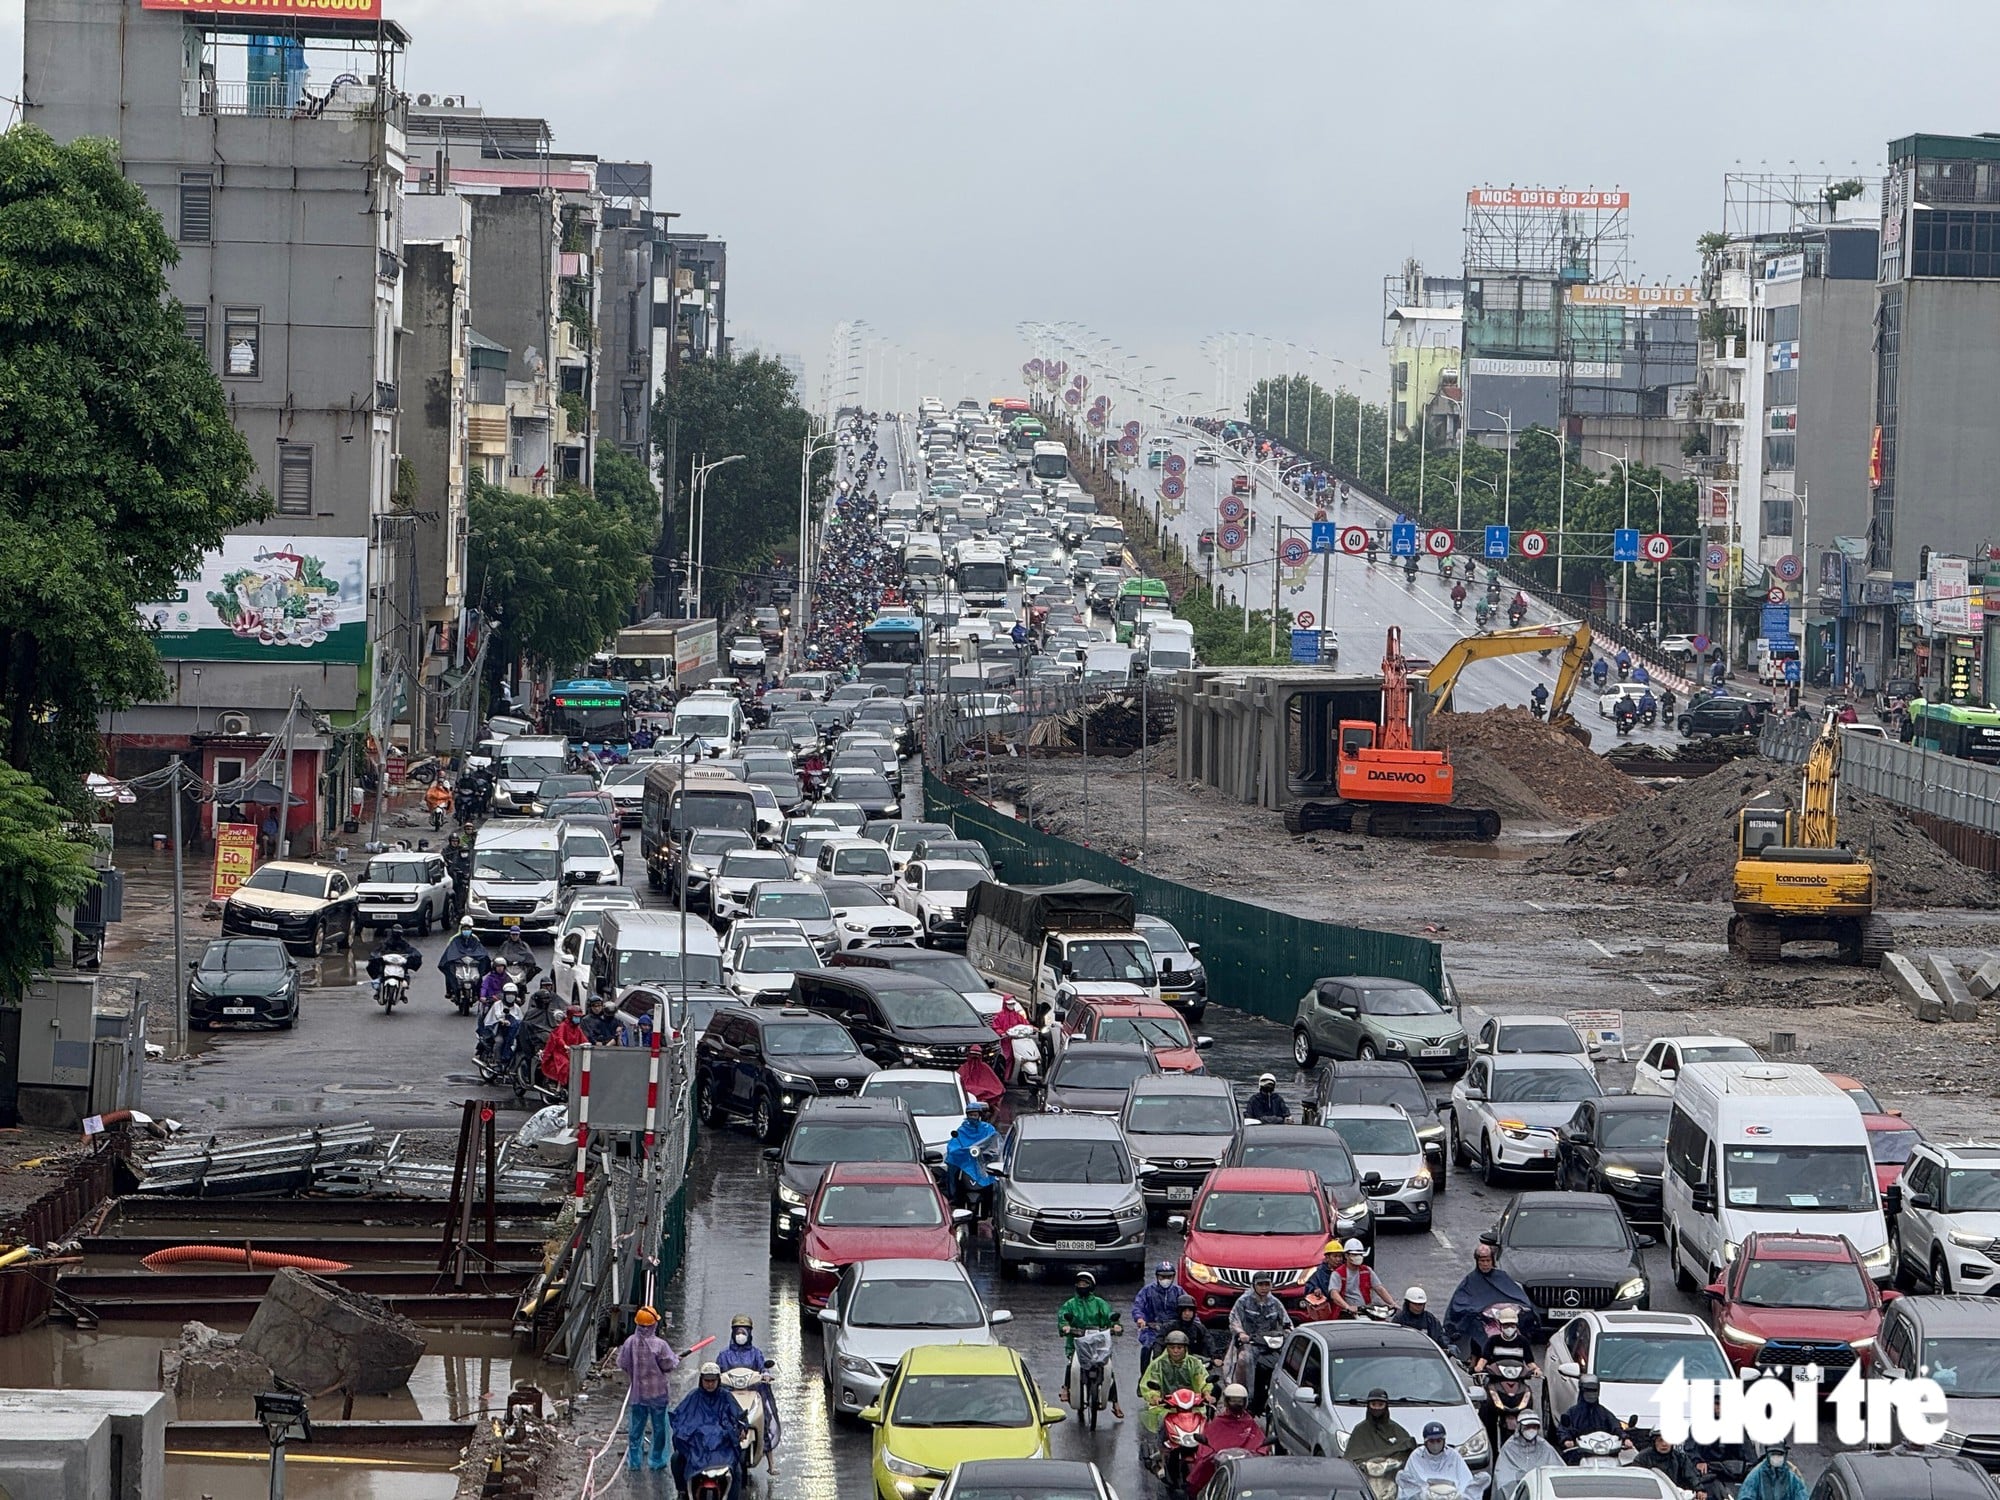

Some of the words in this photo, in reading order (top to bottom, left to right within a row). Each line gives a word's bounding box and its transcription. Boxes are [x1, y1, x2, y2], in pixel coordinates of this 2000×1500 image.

[1479, 191, 1517, 204] MQC:
[1520, 192, 1556, 204] 0916
[1559, 193, 1577, 205] 80
[1581, 193, 1599, 205] 20
[1603, 193, 1621, 205] 99
[1583, 286, 1633, 300] MQC:
[1638, 288, 1685, 302] 0916
[1477, 359, 1514, 373] MQC:
[1518, 360, 1550, 373] 0916
[1348, 534, 1361, 547] 60
[1434, 536, 1446, 548] 60
[1527, 538, 1539, 551] 60
[1651, 542, 1665, 554] 40
[1367, 770, 1426, 784] DAEWOO
[1775, 874, 1828, 884] kanamoto
